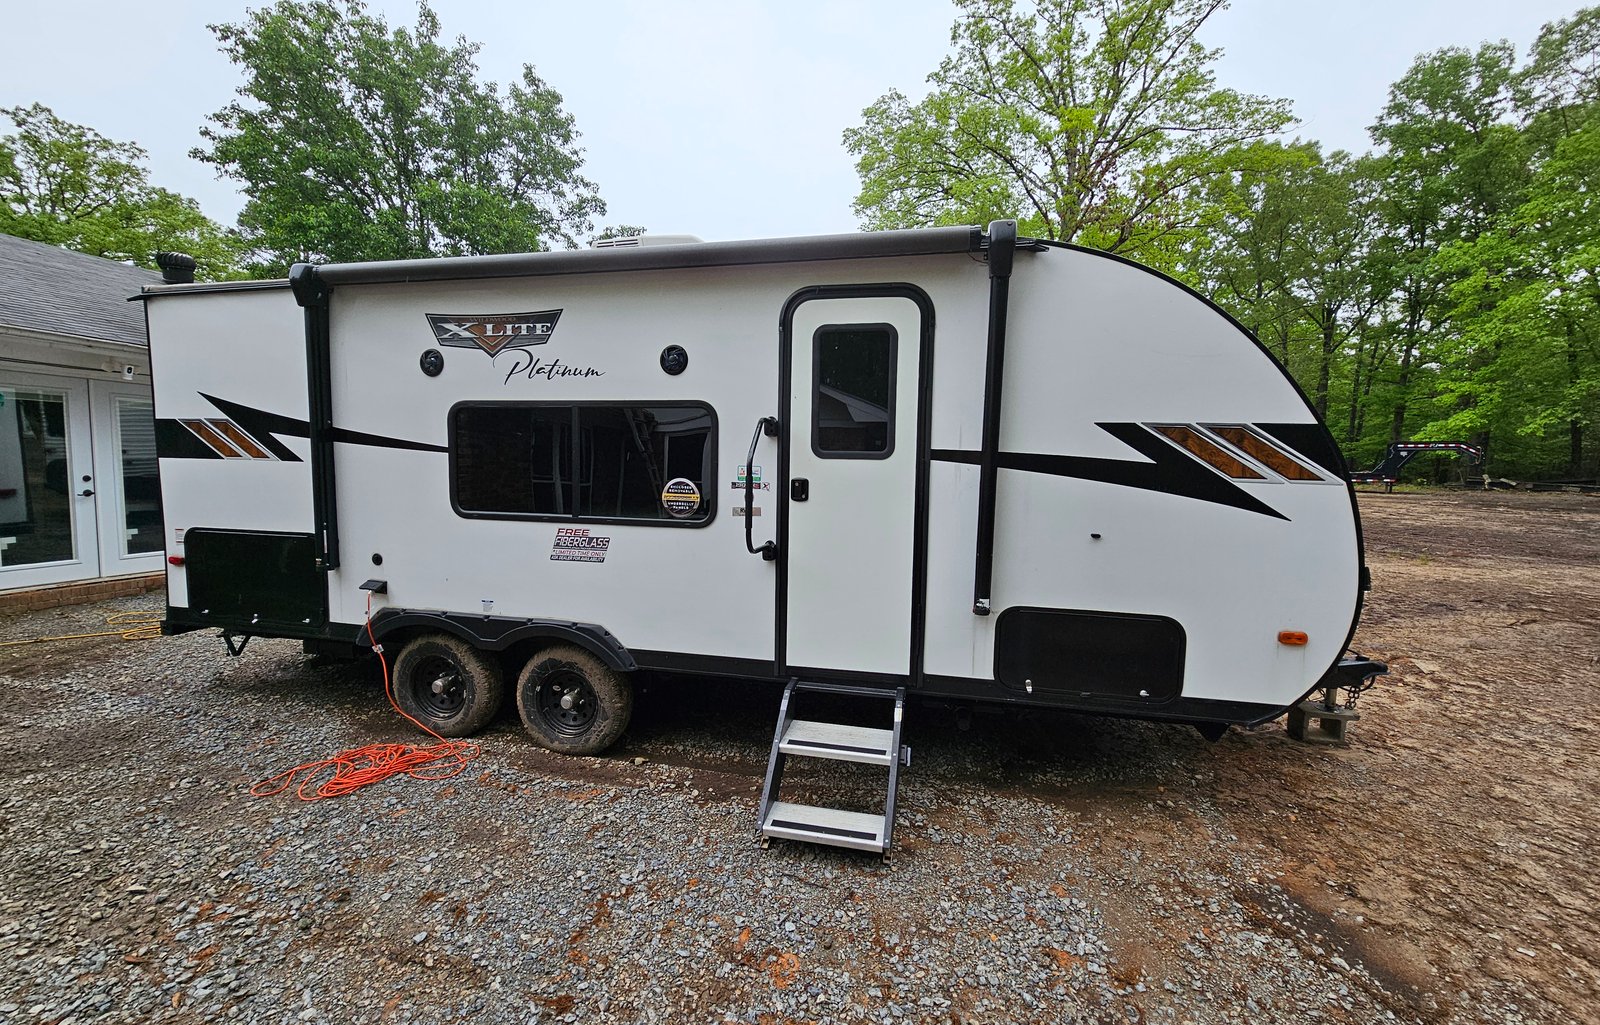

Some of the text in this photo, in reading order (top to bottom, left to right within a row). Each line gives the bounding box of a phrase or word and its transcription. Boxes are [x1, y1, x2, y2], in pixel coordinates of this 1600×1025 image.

[437, 322, 551, 339] X LITE
[493, 348, 606, 386] Platinum
[554, 537, 609, 548] FIBERGLASS
